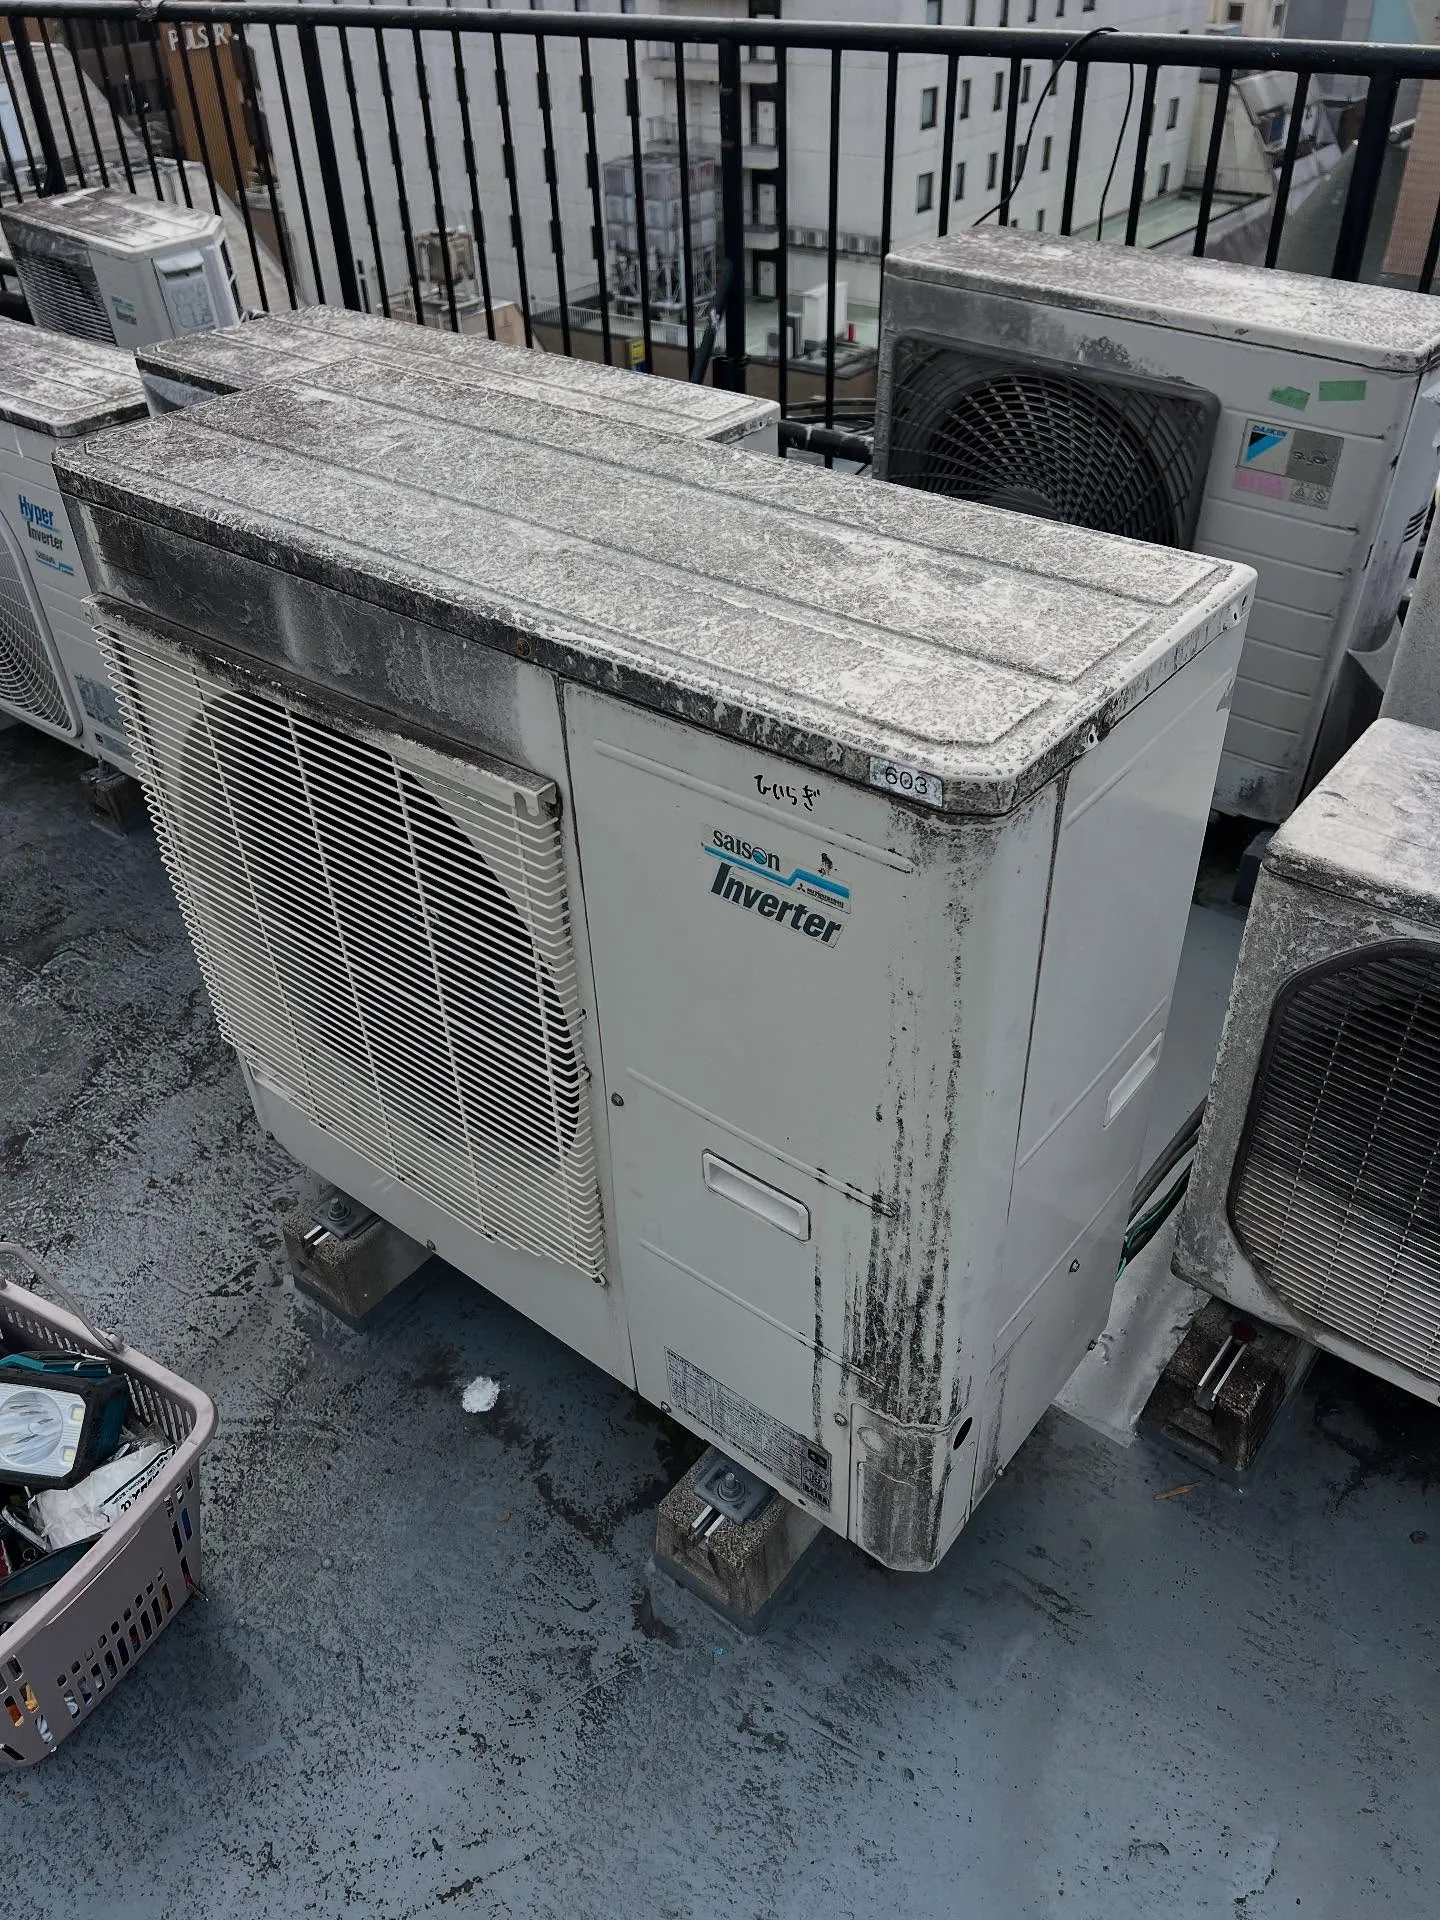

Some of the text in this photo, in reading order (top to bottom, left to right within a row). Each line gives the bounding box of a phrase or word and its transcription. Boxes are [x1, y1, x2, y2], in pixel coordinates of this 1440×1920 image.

[18, 494, 54, 525] Hyper
[26, 520, 63, 550] Inverter
[753, 774, 821, 811] ひいらぎ
[884, 766, 929, 795] 603
[712, 829, 781, 872] saison
[710, 862, 842, 944] Inverter
